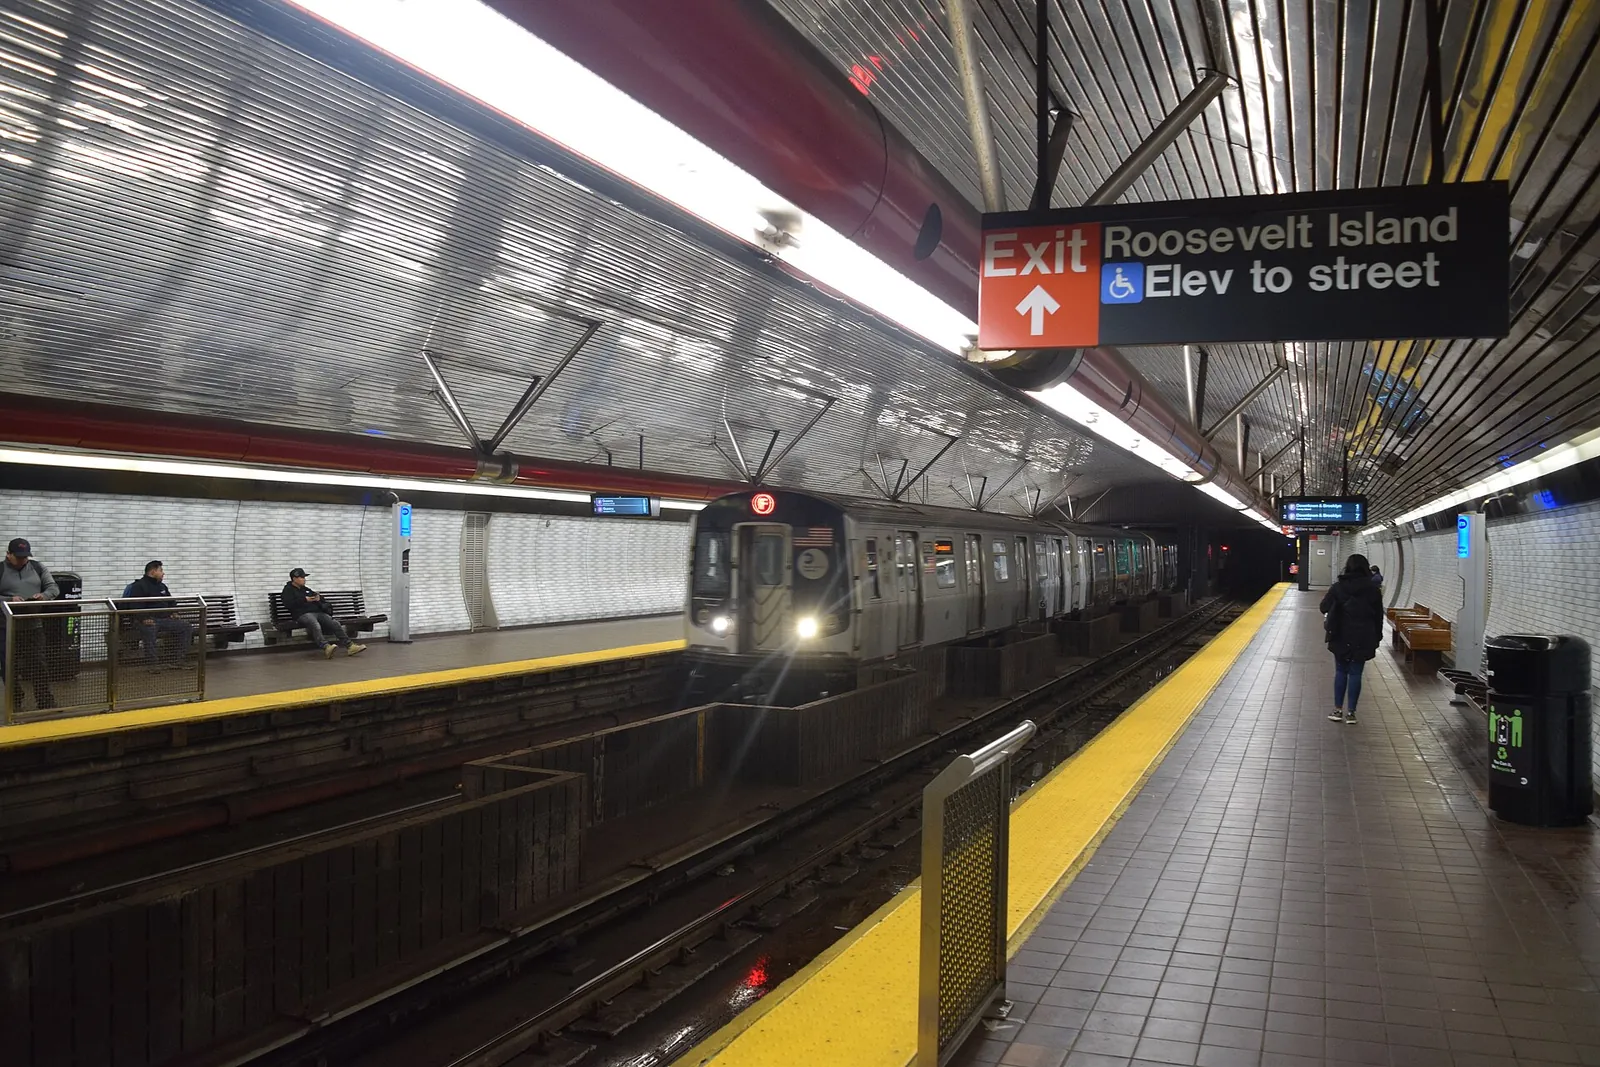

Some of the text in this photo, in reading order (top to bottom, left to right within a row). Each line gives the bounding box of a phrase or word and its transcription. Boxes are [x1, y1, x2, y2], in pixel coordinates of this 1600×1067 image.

[984, 229, 1088, 278] Exit
[1104, 207, 1458, 259] Roosevelt Island
[1146, 252, 1440, 298] Elev to street
[757, 497, 769, 510] F
